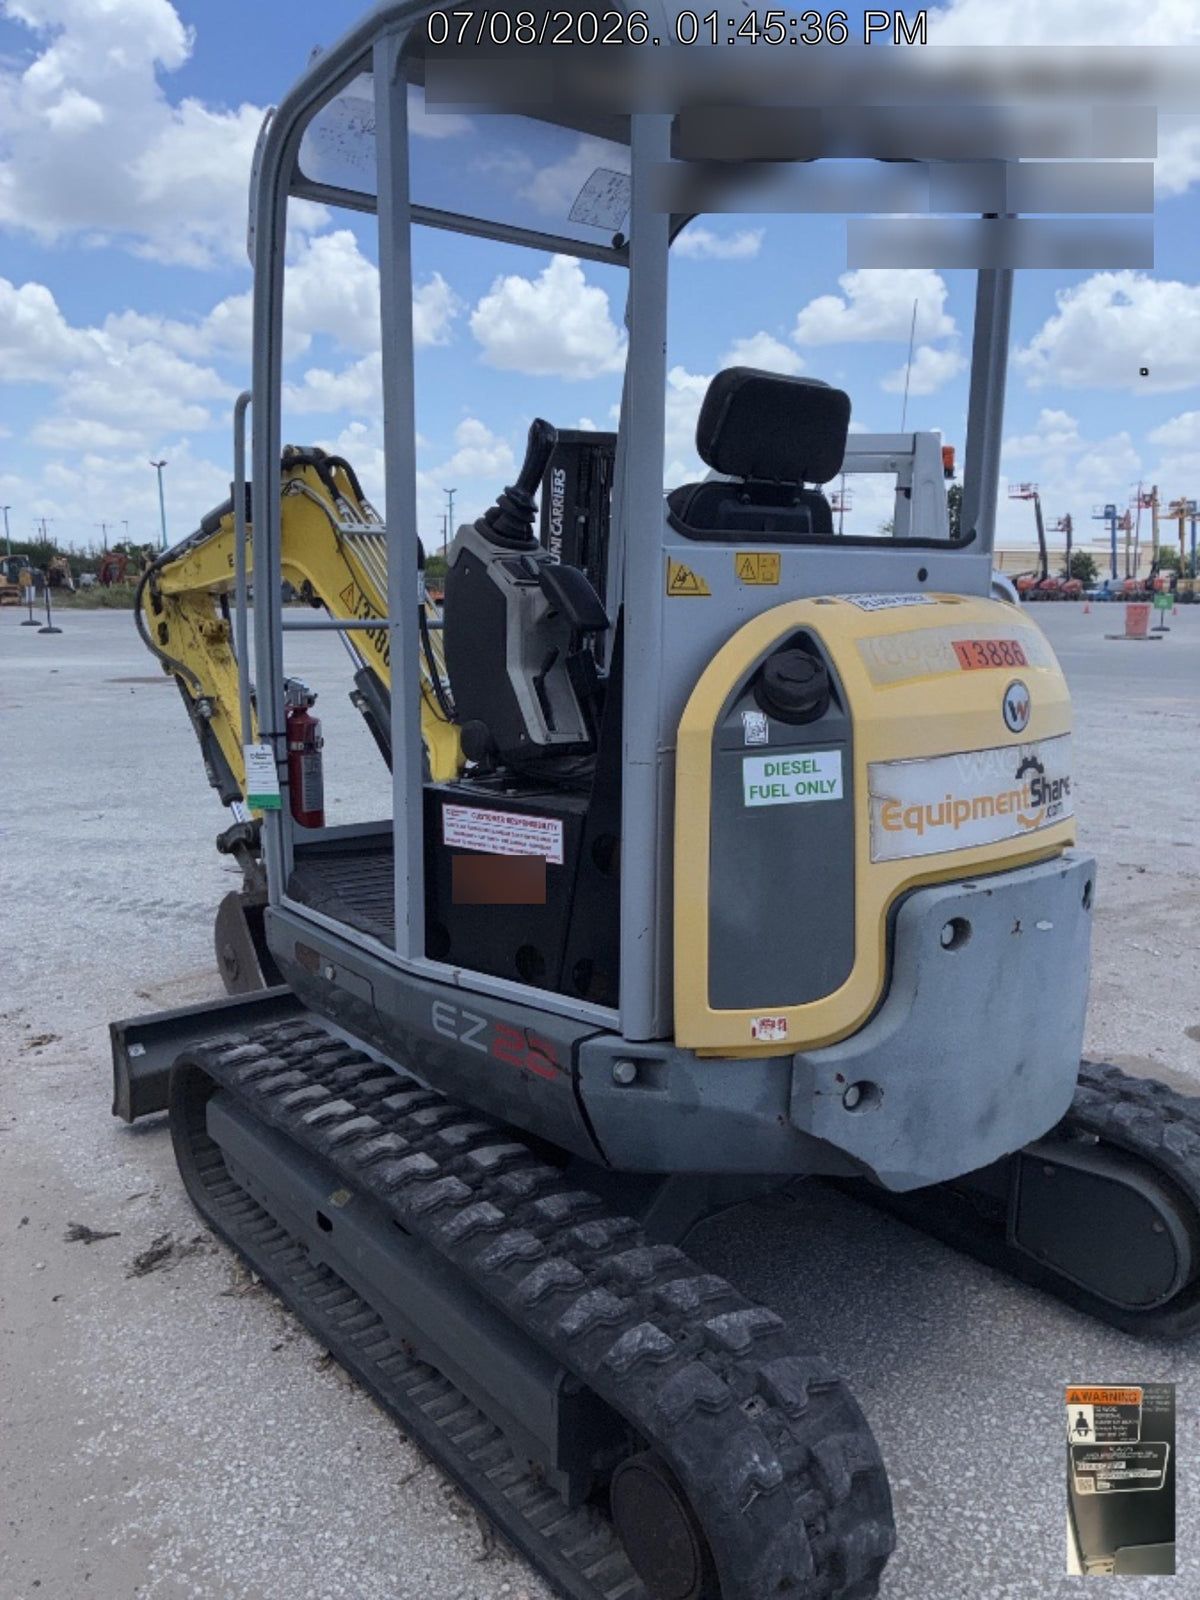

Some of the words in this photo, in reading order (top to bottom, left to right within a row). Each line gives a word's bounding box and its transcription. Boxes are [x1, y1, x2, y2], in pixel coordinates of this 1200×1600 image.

[959, 640, 1026, 668] 13886
[764, 760, 822, 777] DIESEL
[749, 783, 790, 800] FUEL
[795, 779, 837, 796] ONLY
